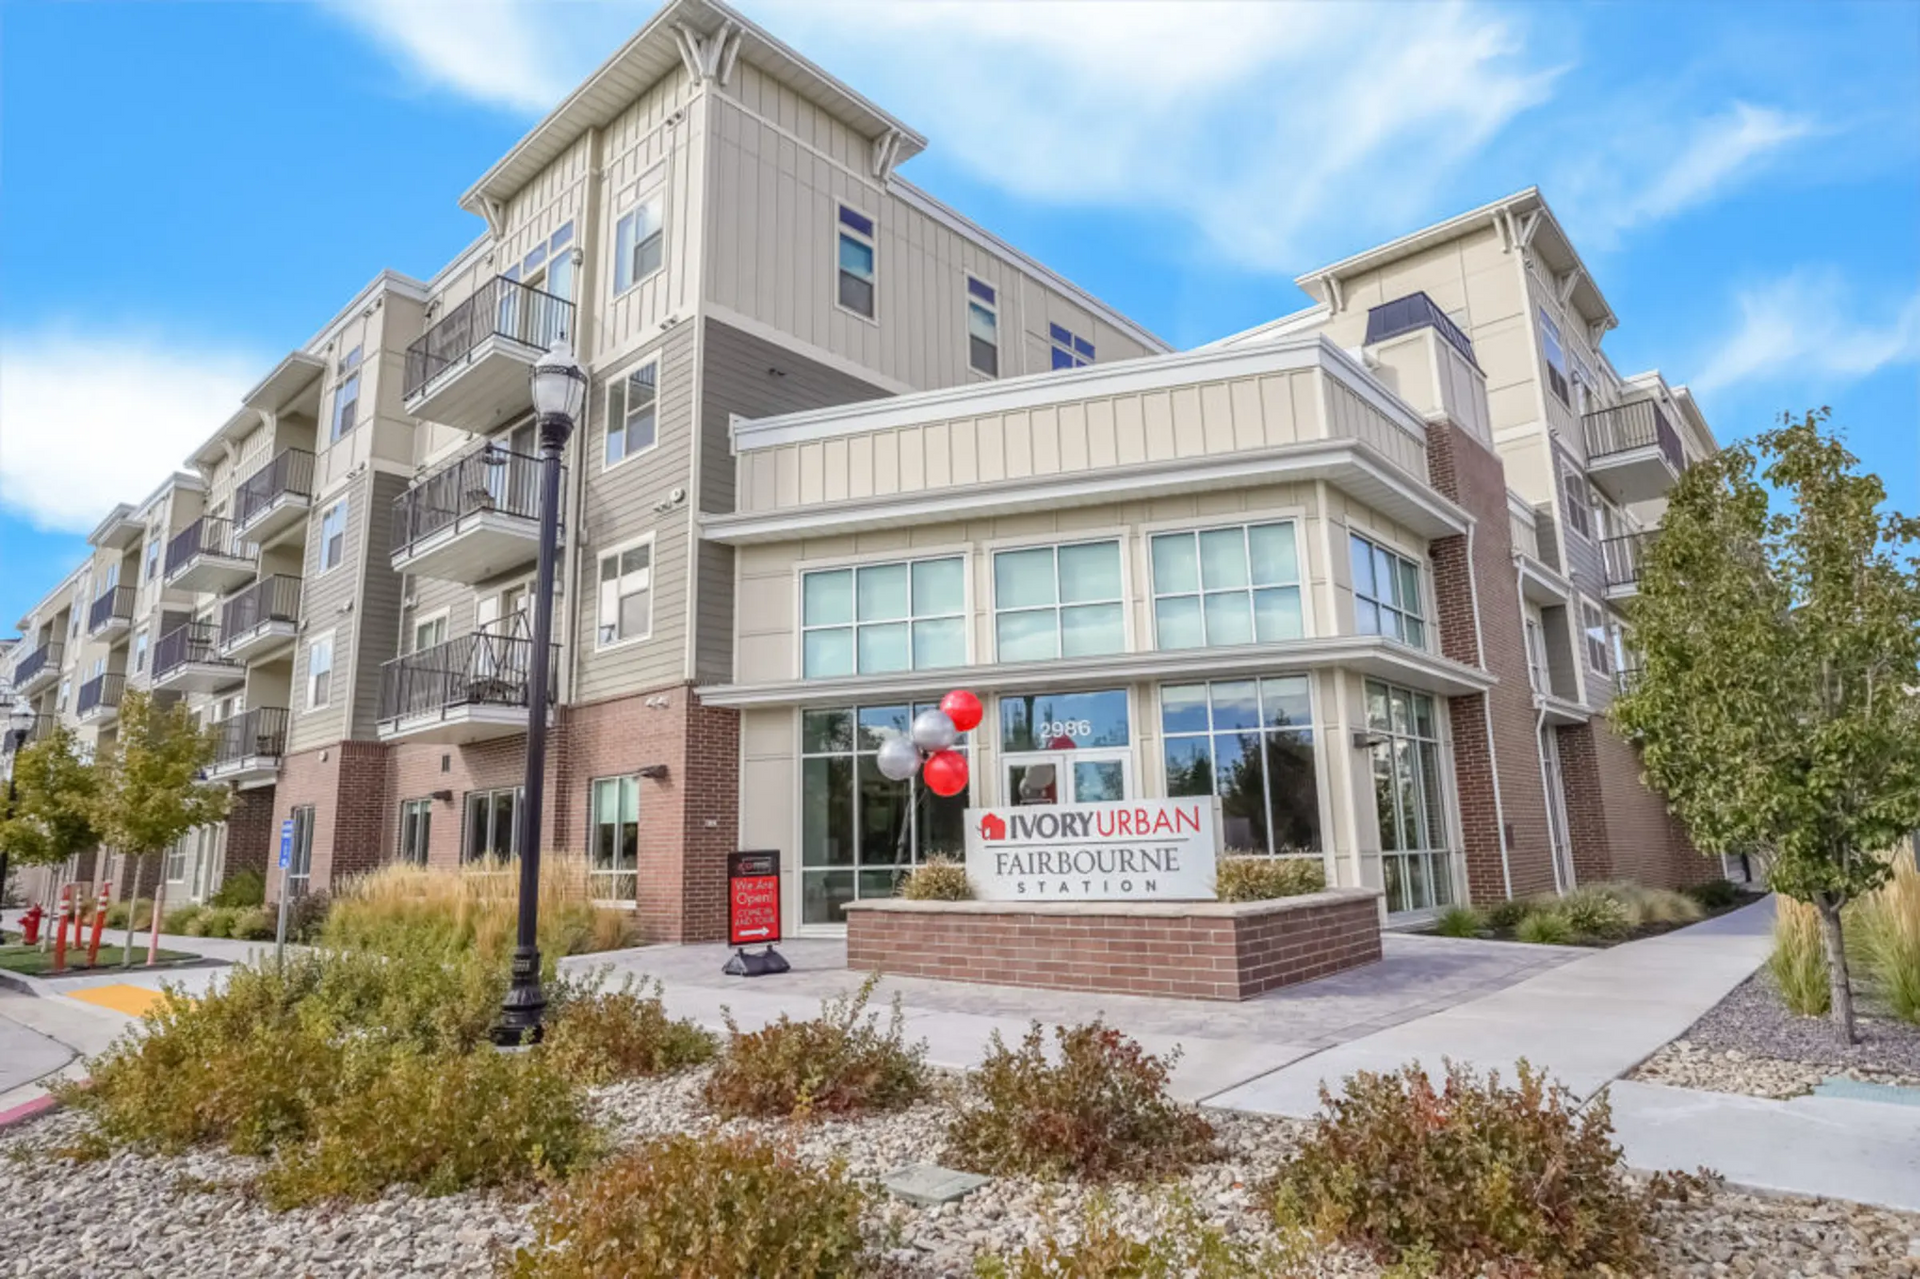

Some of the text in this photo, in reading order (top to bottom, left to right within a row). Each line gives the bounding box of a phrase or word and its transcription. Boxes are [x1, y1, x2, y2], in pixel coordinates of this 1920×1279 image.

[1040, 719, 1092, 738] 2986
[995, 847, 1181, 876] FAIRBOURNE
[735, 878, 774, 890] We Are
[1017, 880, 1158, 894] STATION
[736, 891, 773, 907] Open!
